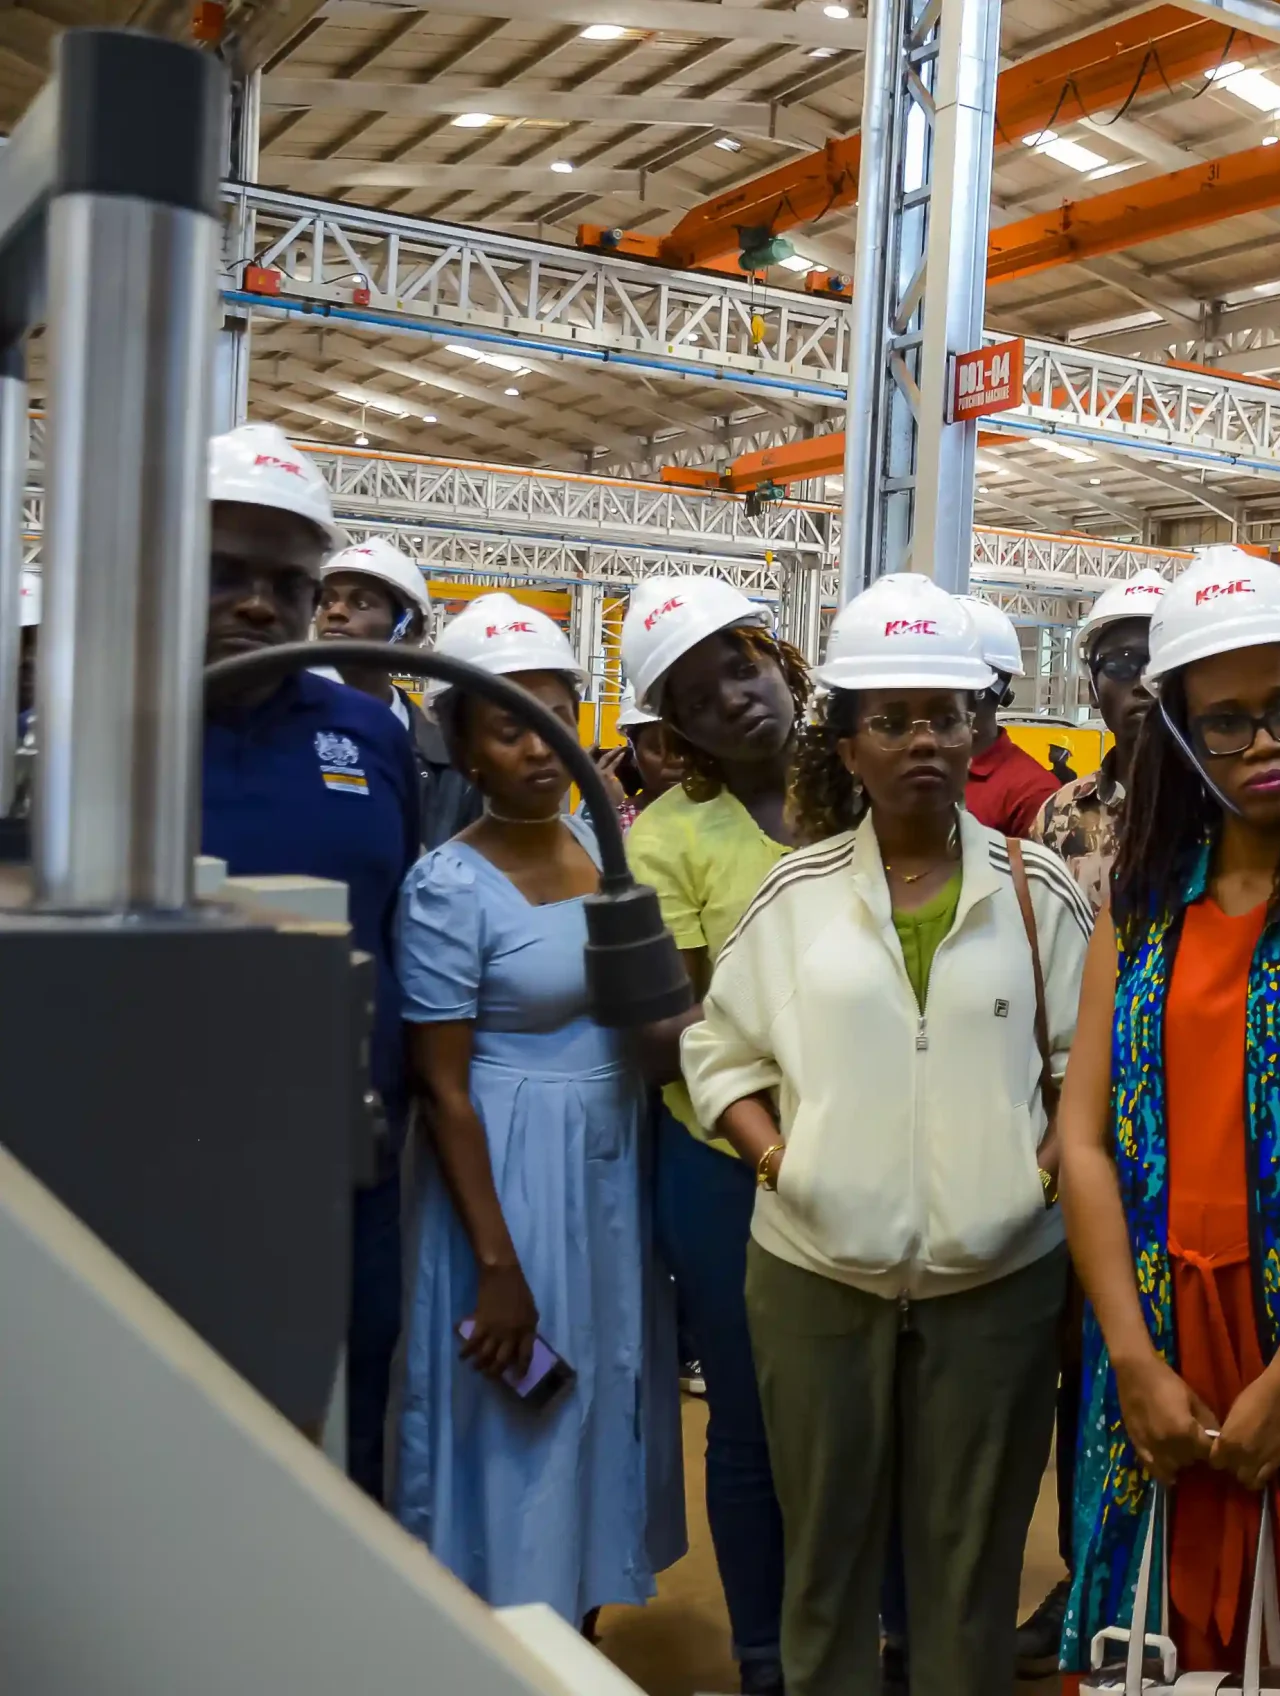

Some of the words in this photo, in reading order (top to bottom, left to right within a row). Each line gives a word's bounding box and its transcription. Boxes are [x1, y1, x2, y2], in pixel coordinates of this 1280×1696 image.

[1195, 579, 1255, 606] KMC
[643, 595, 689, 632] KMC
[884, 619, 938, 637] KMC
